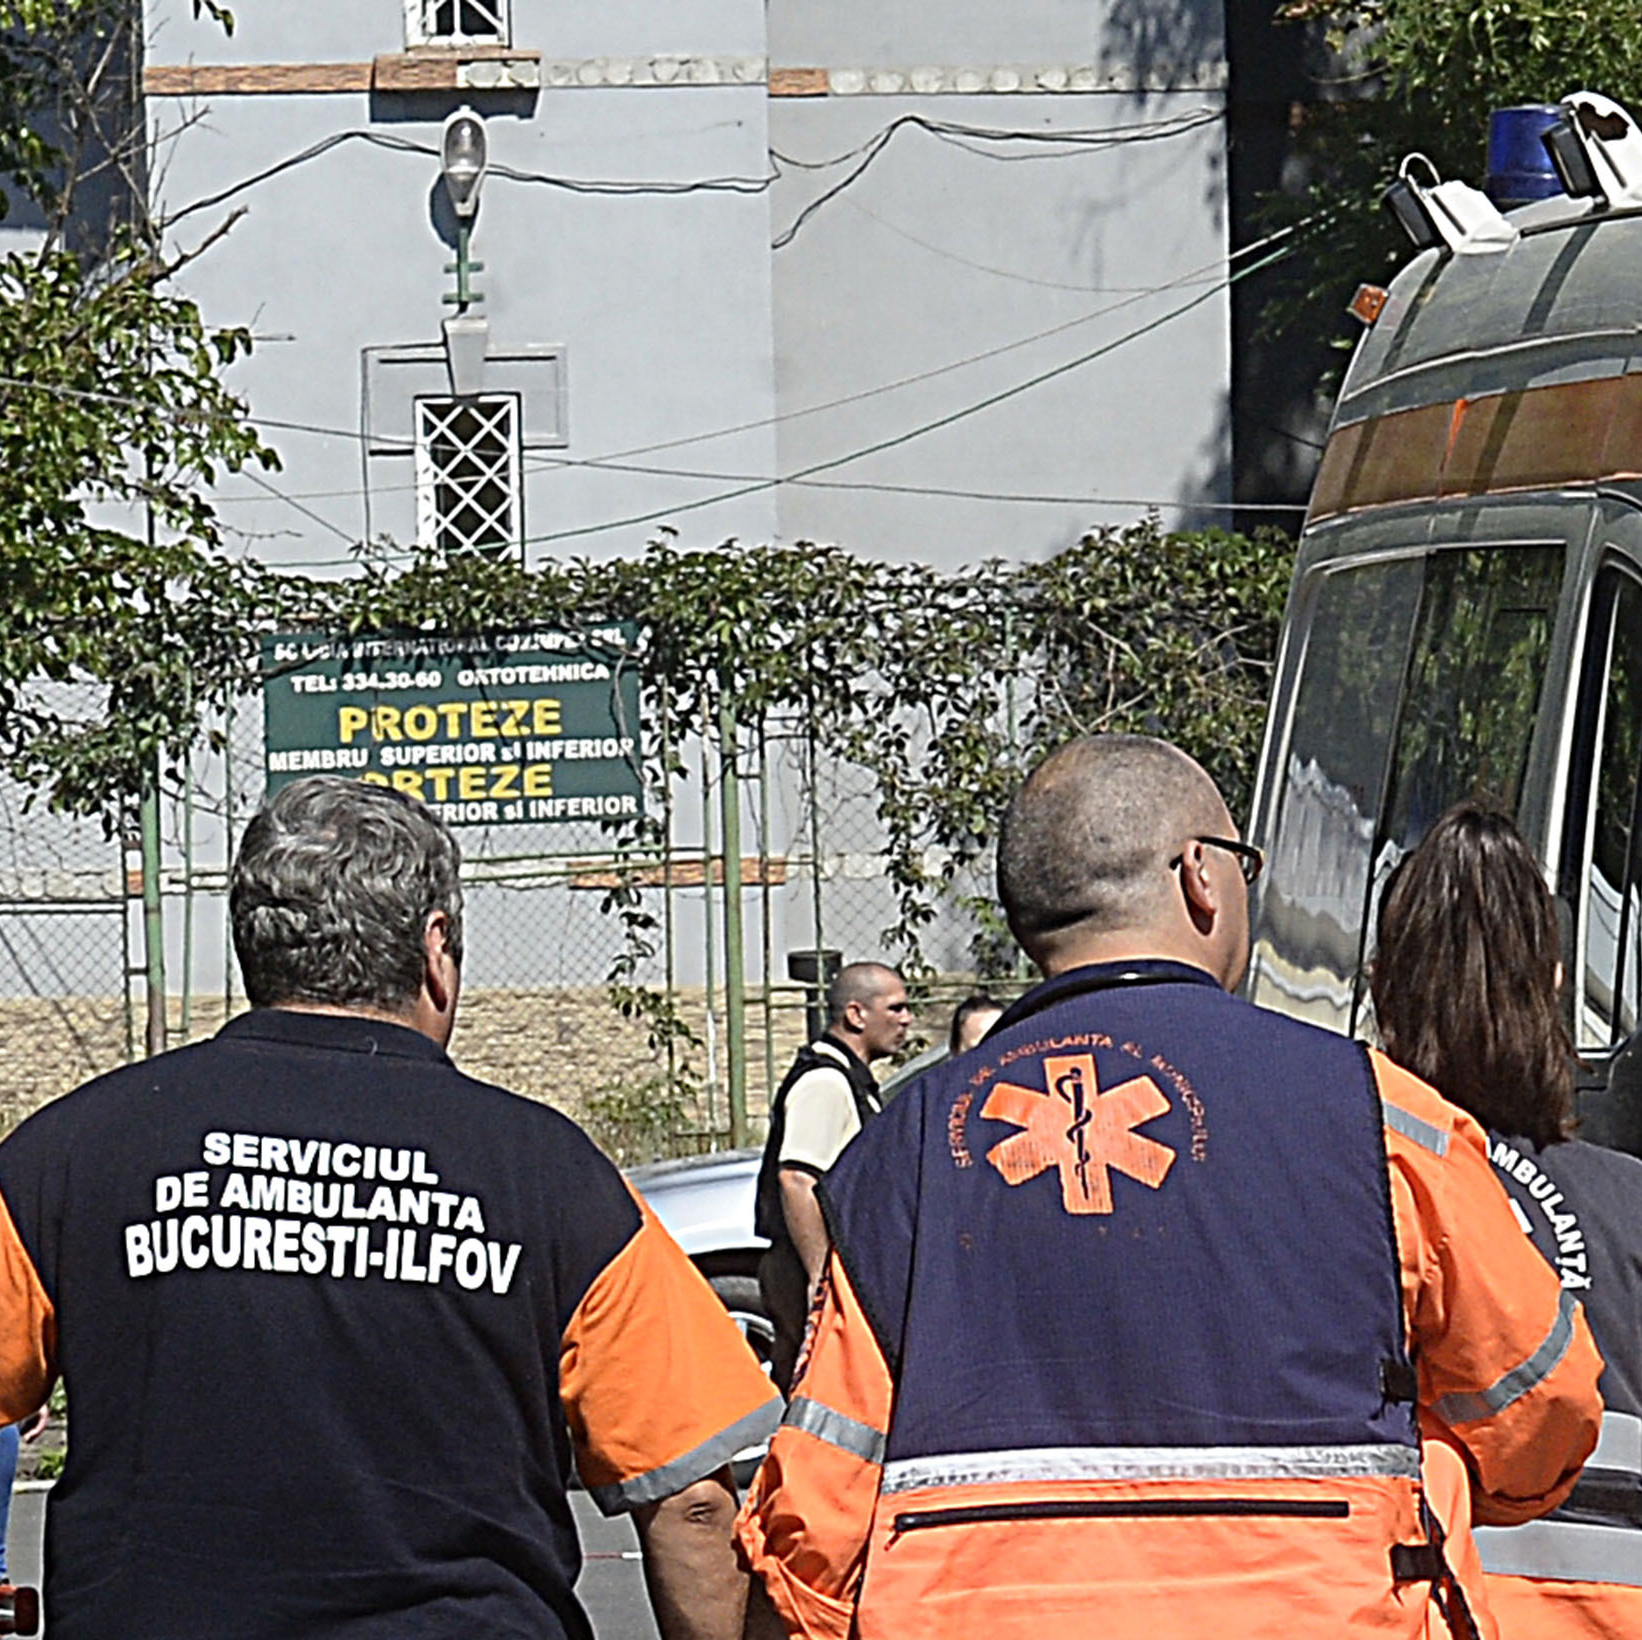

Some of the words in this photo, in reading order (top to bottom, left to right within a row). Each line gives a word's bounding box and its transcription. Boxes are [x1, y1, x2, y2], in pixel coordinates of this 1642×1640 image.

[338, 699, 563, 743] PROTEZE
[268, 748, 369, 772] MEMBRU
[379, 744, 497, 766] SUPERIOR
[526, 737, 635, 760] INFERIOR
[528, 795, 638, 817] INFERIOR
[202, 1132, 439, 1184] SERVICIUL
[156, 1171, 210, 1212] DE
[220, 1172, 485, 1233] AMBULANTA
[124, 1214, 522, 1294] BUCURESTI-ILFOV
